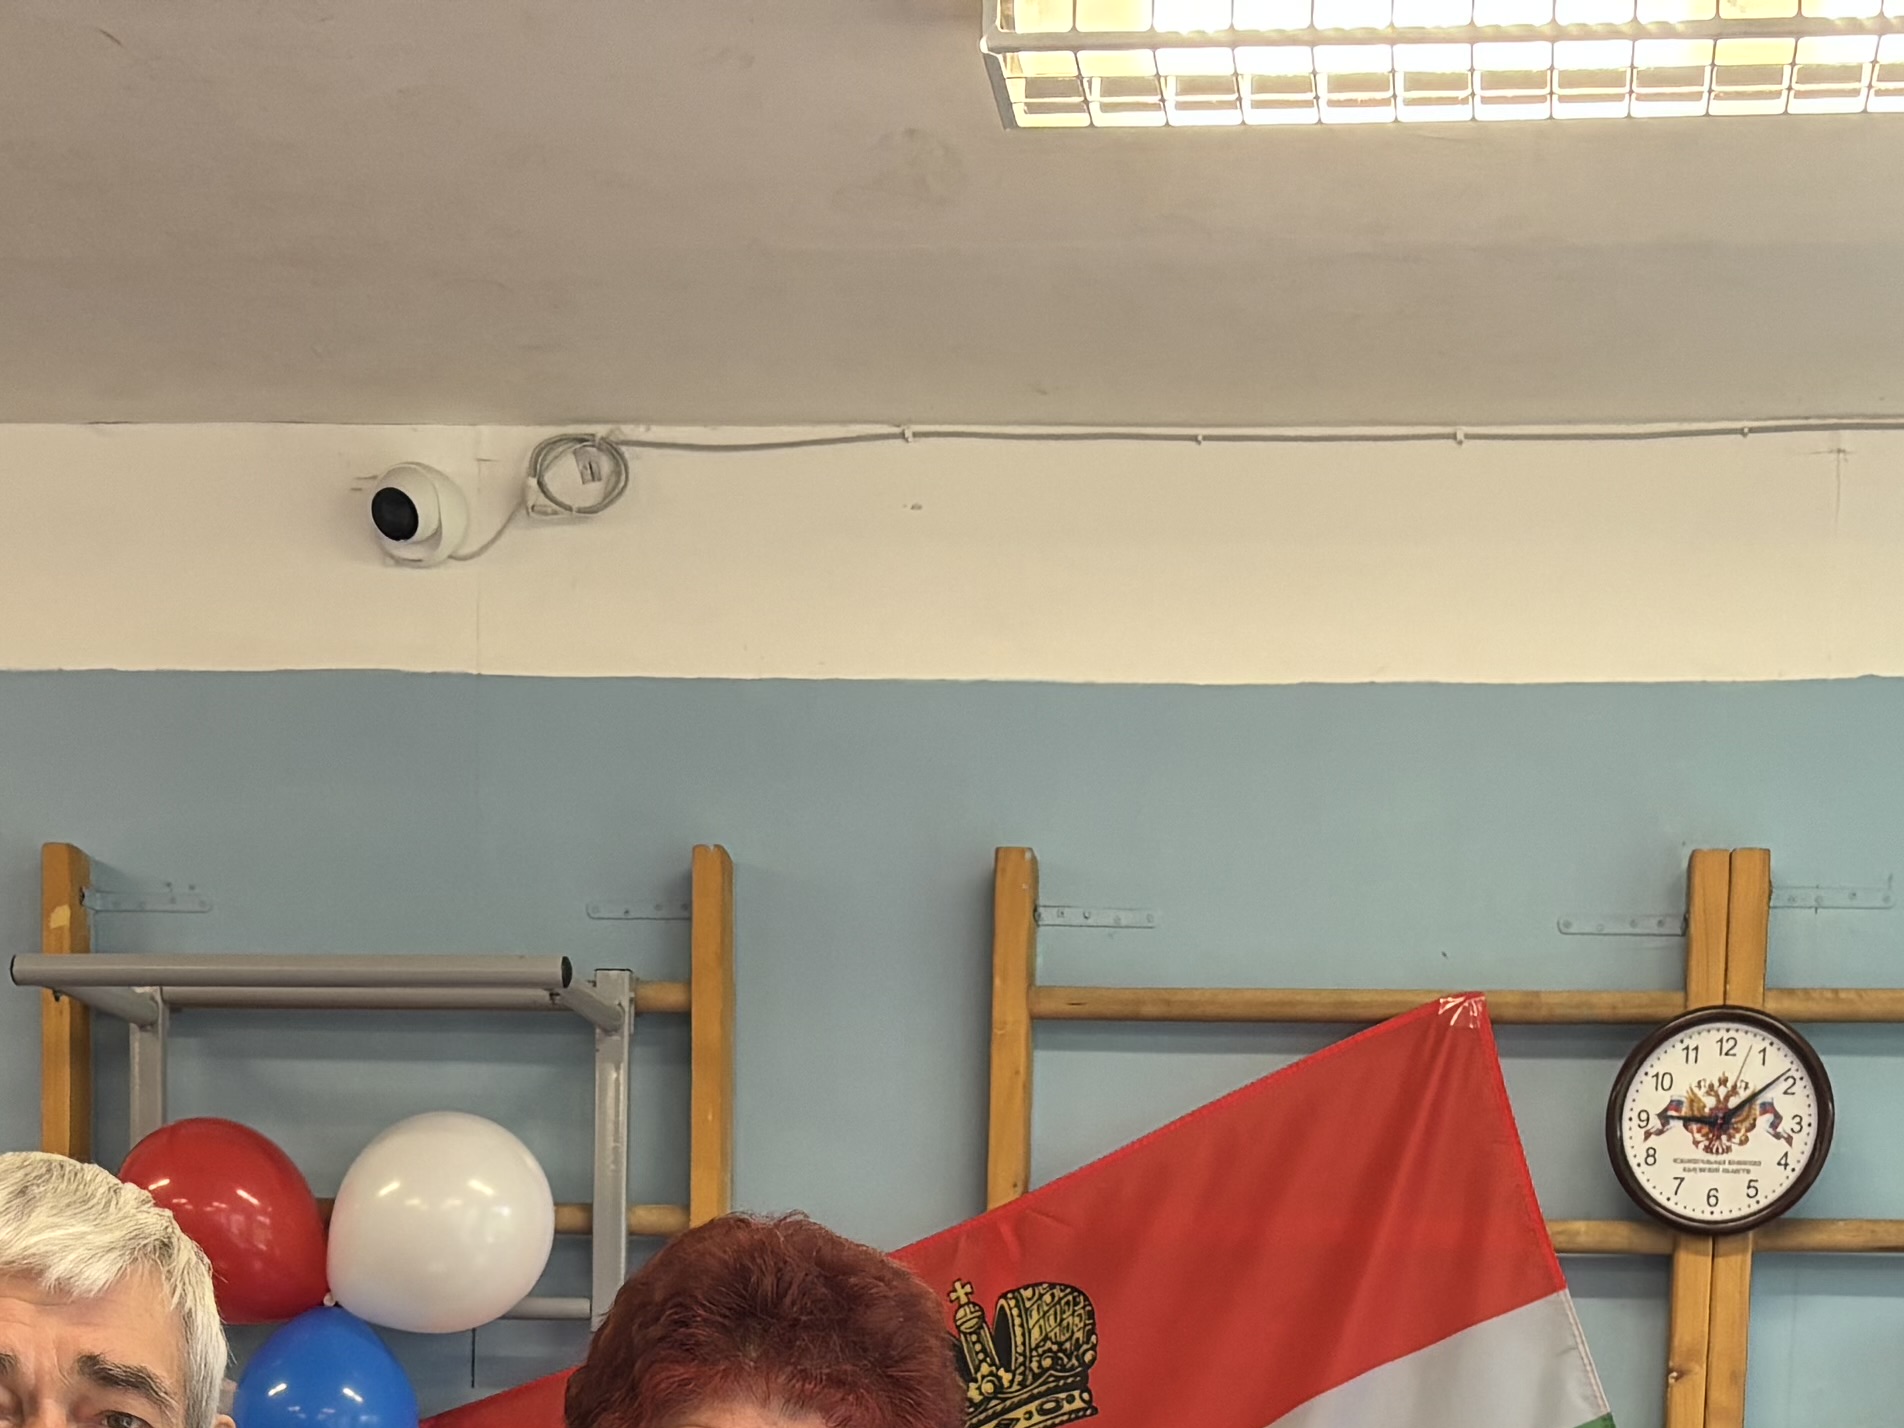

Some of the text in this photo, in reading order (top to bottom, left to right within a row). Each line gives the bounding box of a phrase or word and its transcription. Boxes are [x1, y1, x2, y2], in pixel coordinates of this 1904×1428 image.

[1682, 1044, 1699, 1063] 11
[1716, 1037, 1737, 1056] 12
[1759, 1047, 1766, 1064] 1
[1652, 1071, 1673, 1090] 10
[1783, 1075, 1796, 1094] 2
[1638, 1110, 1649, 1127] 9
[1791, 1114, 1803, 1133] 3
[1644, 1147, 1656, 1165] 8
[1777, 1151, 1789, 1169] 4
[1673, 1177, 1685, 1195] 7
[1746, 1179, 1758, 1197] 5
[1707, 1187, 1719, 1205] 6
